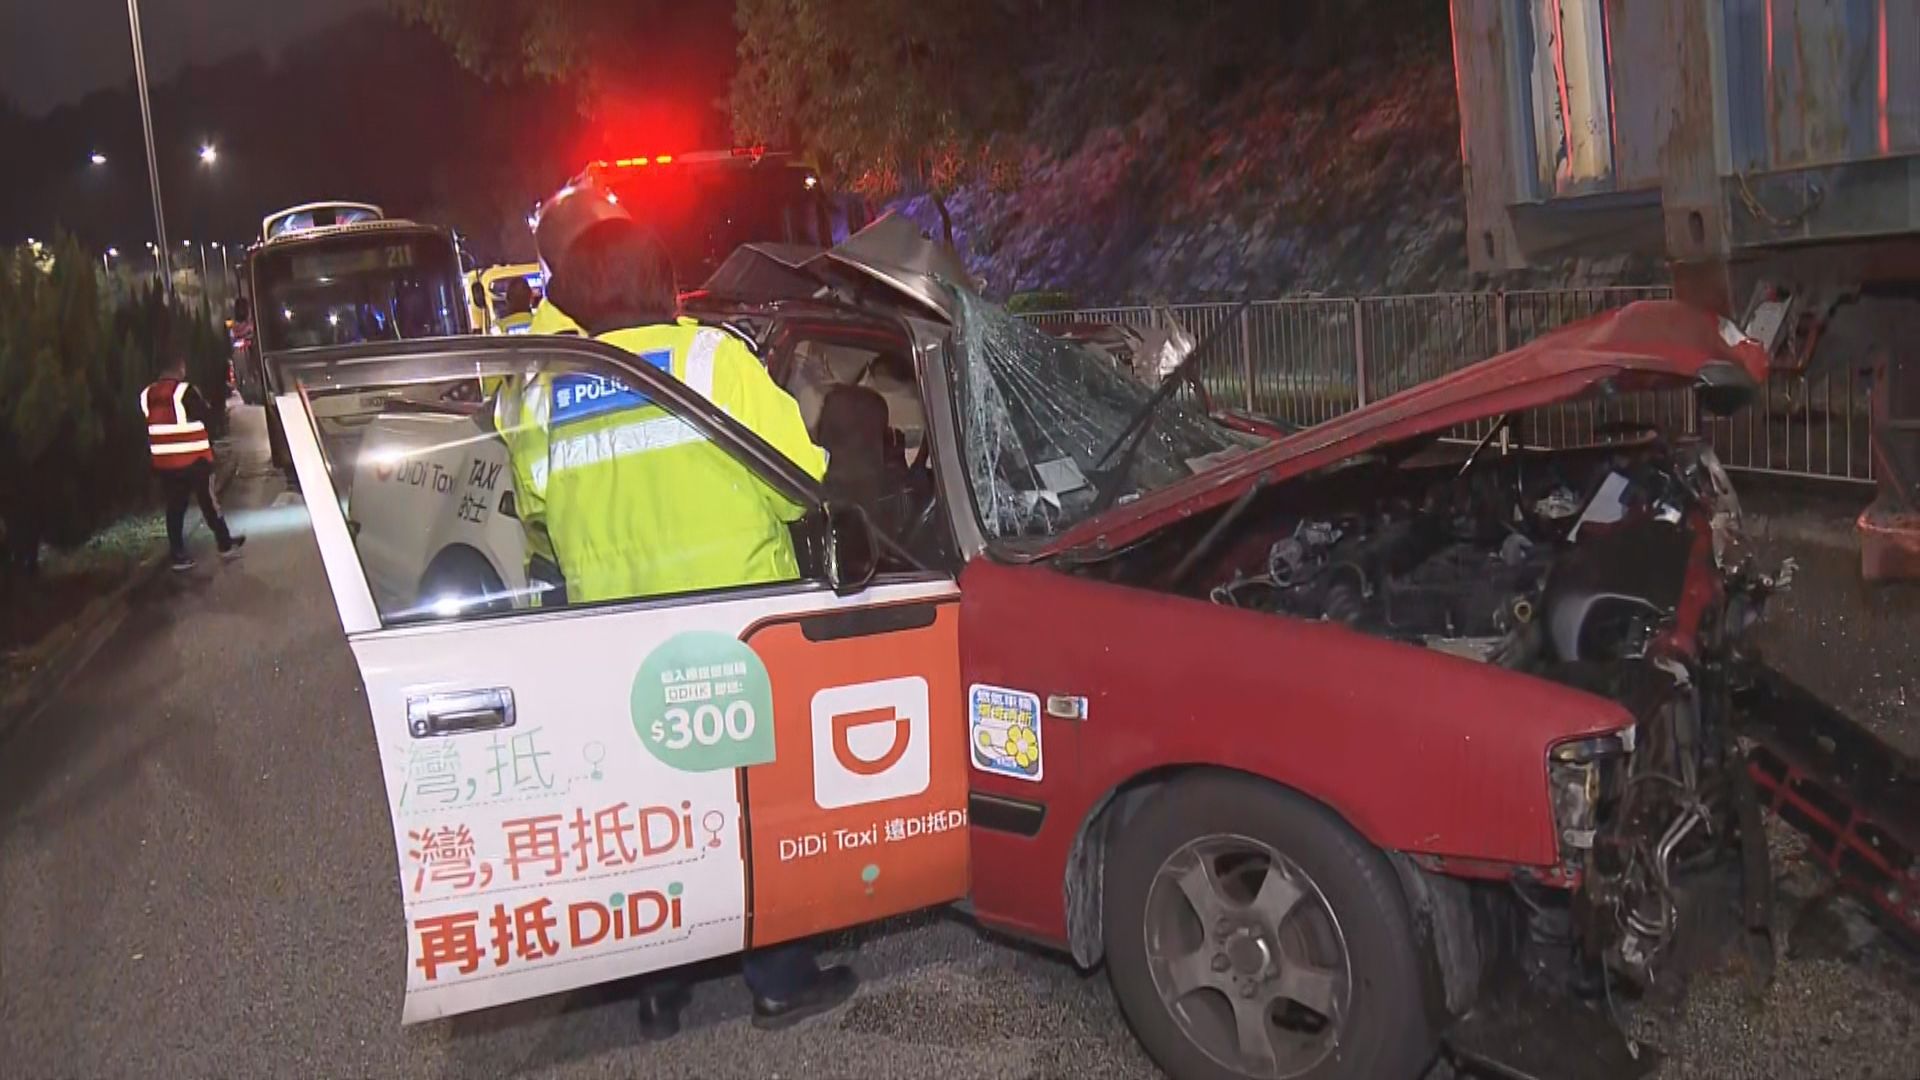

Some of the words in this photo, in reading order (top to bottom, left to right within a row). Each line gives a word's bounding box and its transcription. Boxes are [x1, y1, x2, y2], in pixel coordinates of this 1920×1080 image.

[575, 374, 630, 403] POLIC
[468, 459, 503, 491] TAXI
[457, 491, 488, 524] 的士
[651, 699, 756, 750] $300
[779, 832, 828, 862] DiDi
[833, 823, 878, 850] Taxi
